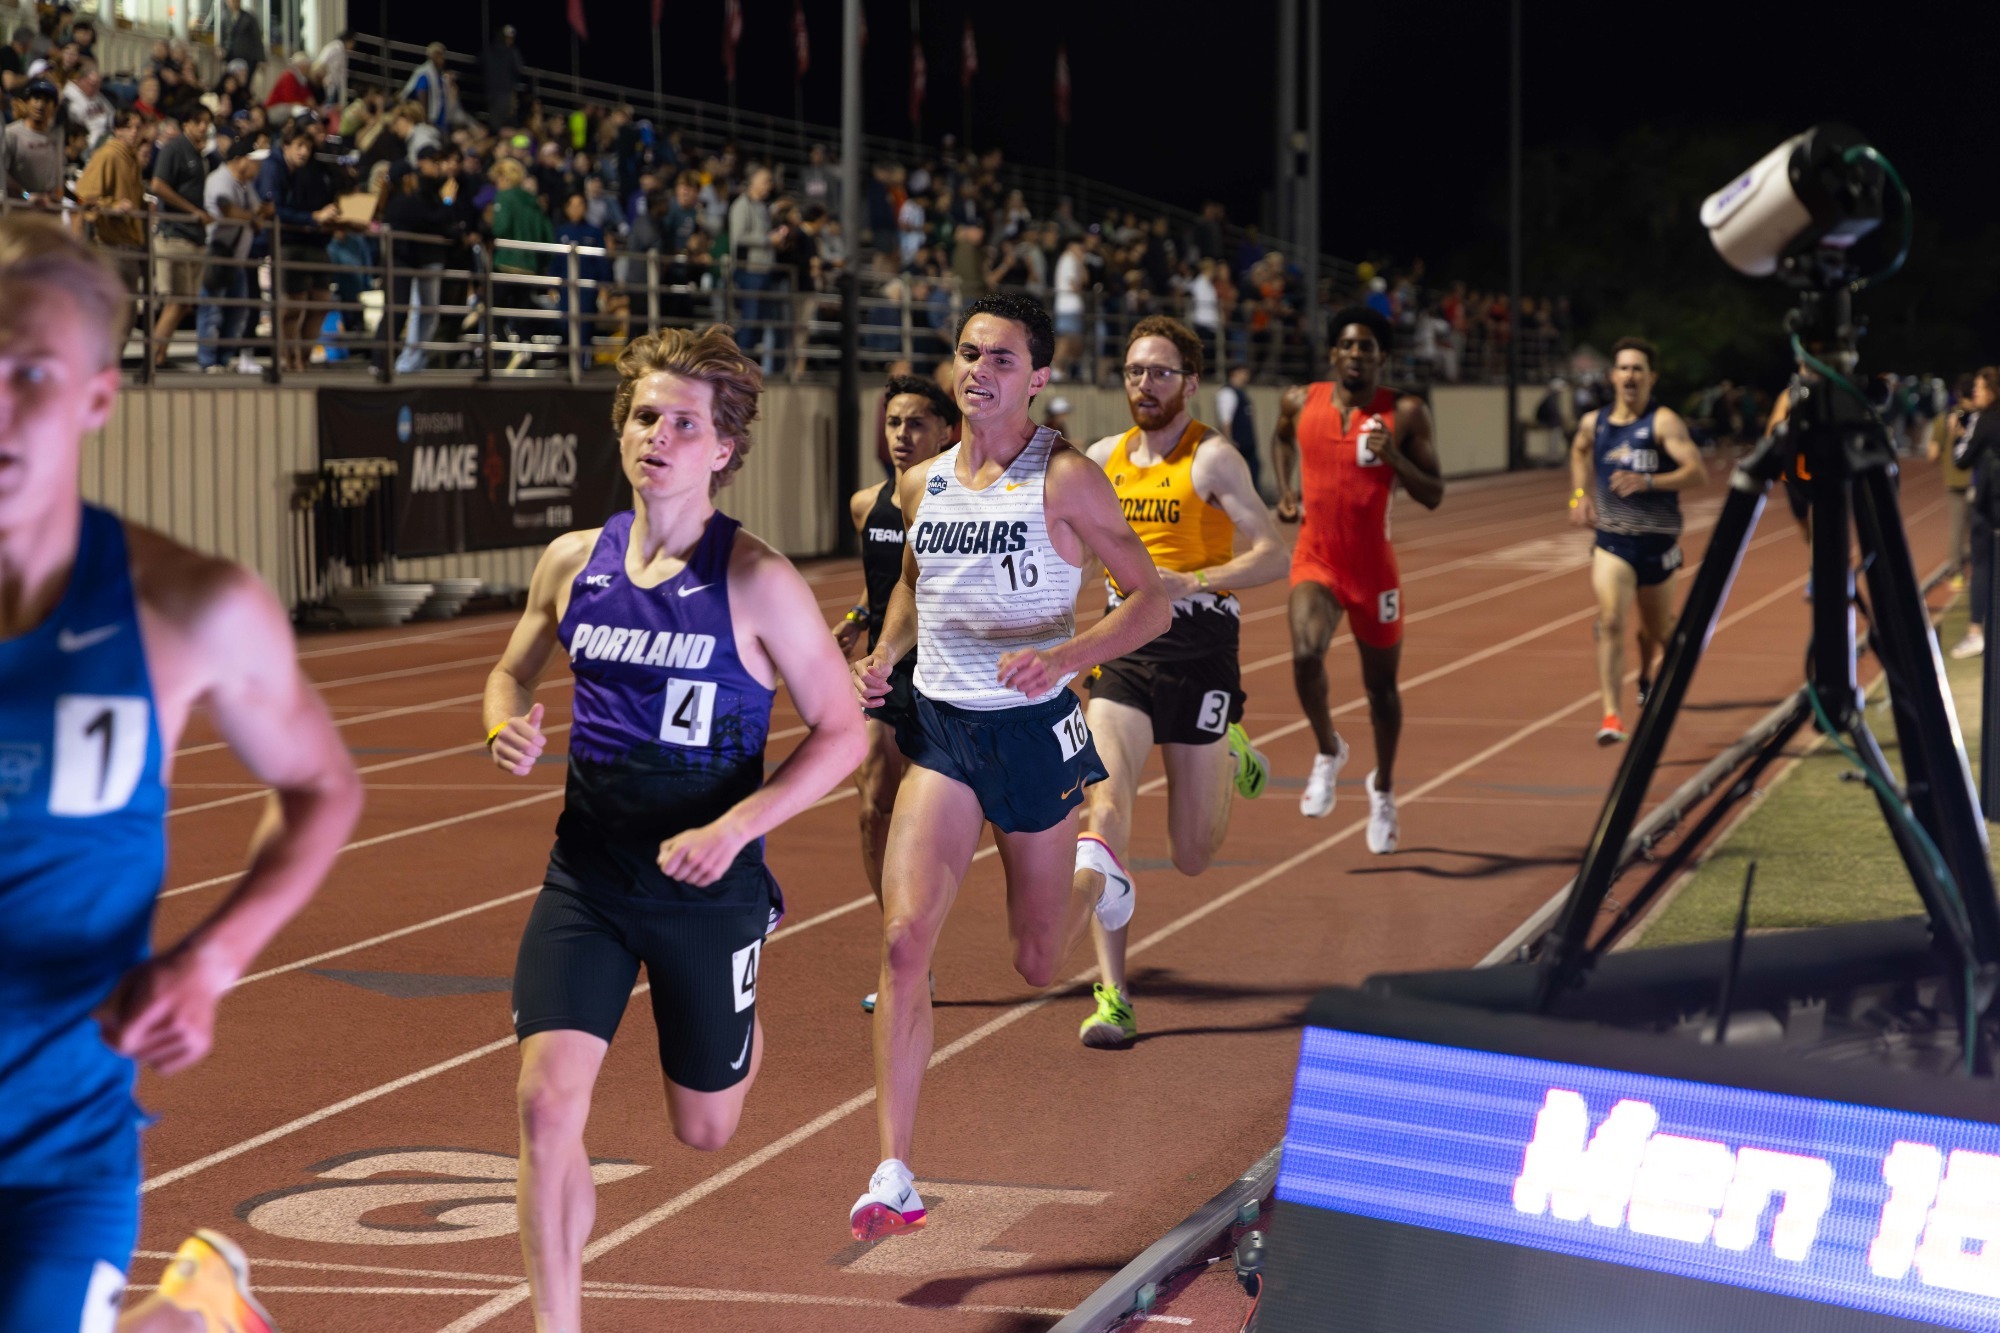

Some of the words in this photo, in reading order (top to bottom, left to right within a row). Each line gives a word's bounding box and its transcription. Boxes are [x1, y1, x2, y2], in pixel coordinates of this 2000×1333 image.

[411, 445, 478, 492] MAKE
[505, 413, 578, 506] YOURS
[1119, 498, 1180, 523] OMING
[868, 527, 904, 543] TEAM
[916, 521, 1028, 555] COUGARS
[1001, 550, 1039, 592] 16
[1385, 593, 1397, 620] 5
[569, 623, 716, 669] PORTLAND
[671, 685, 703, 741] 4
[1063, 706, 1086, 752] 16
[1205, 694, 1226, 729] 3
[84, 709, 114, 802] 1
[741, 946, 756, 998] 4
[1513, 1088, 1833, 1262] Men
